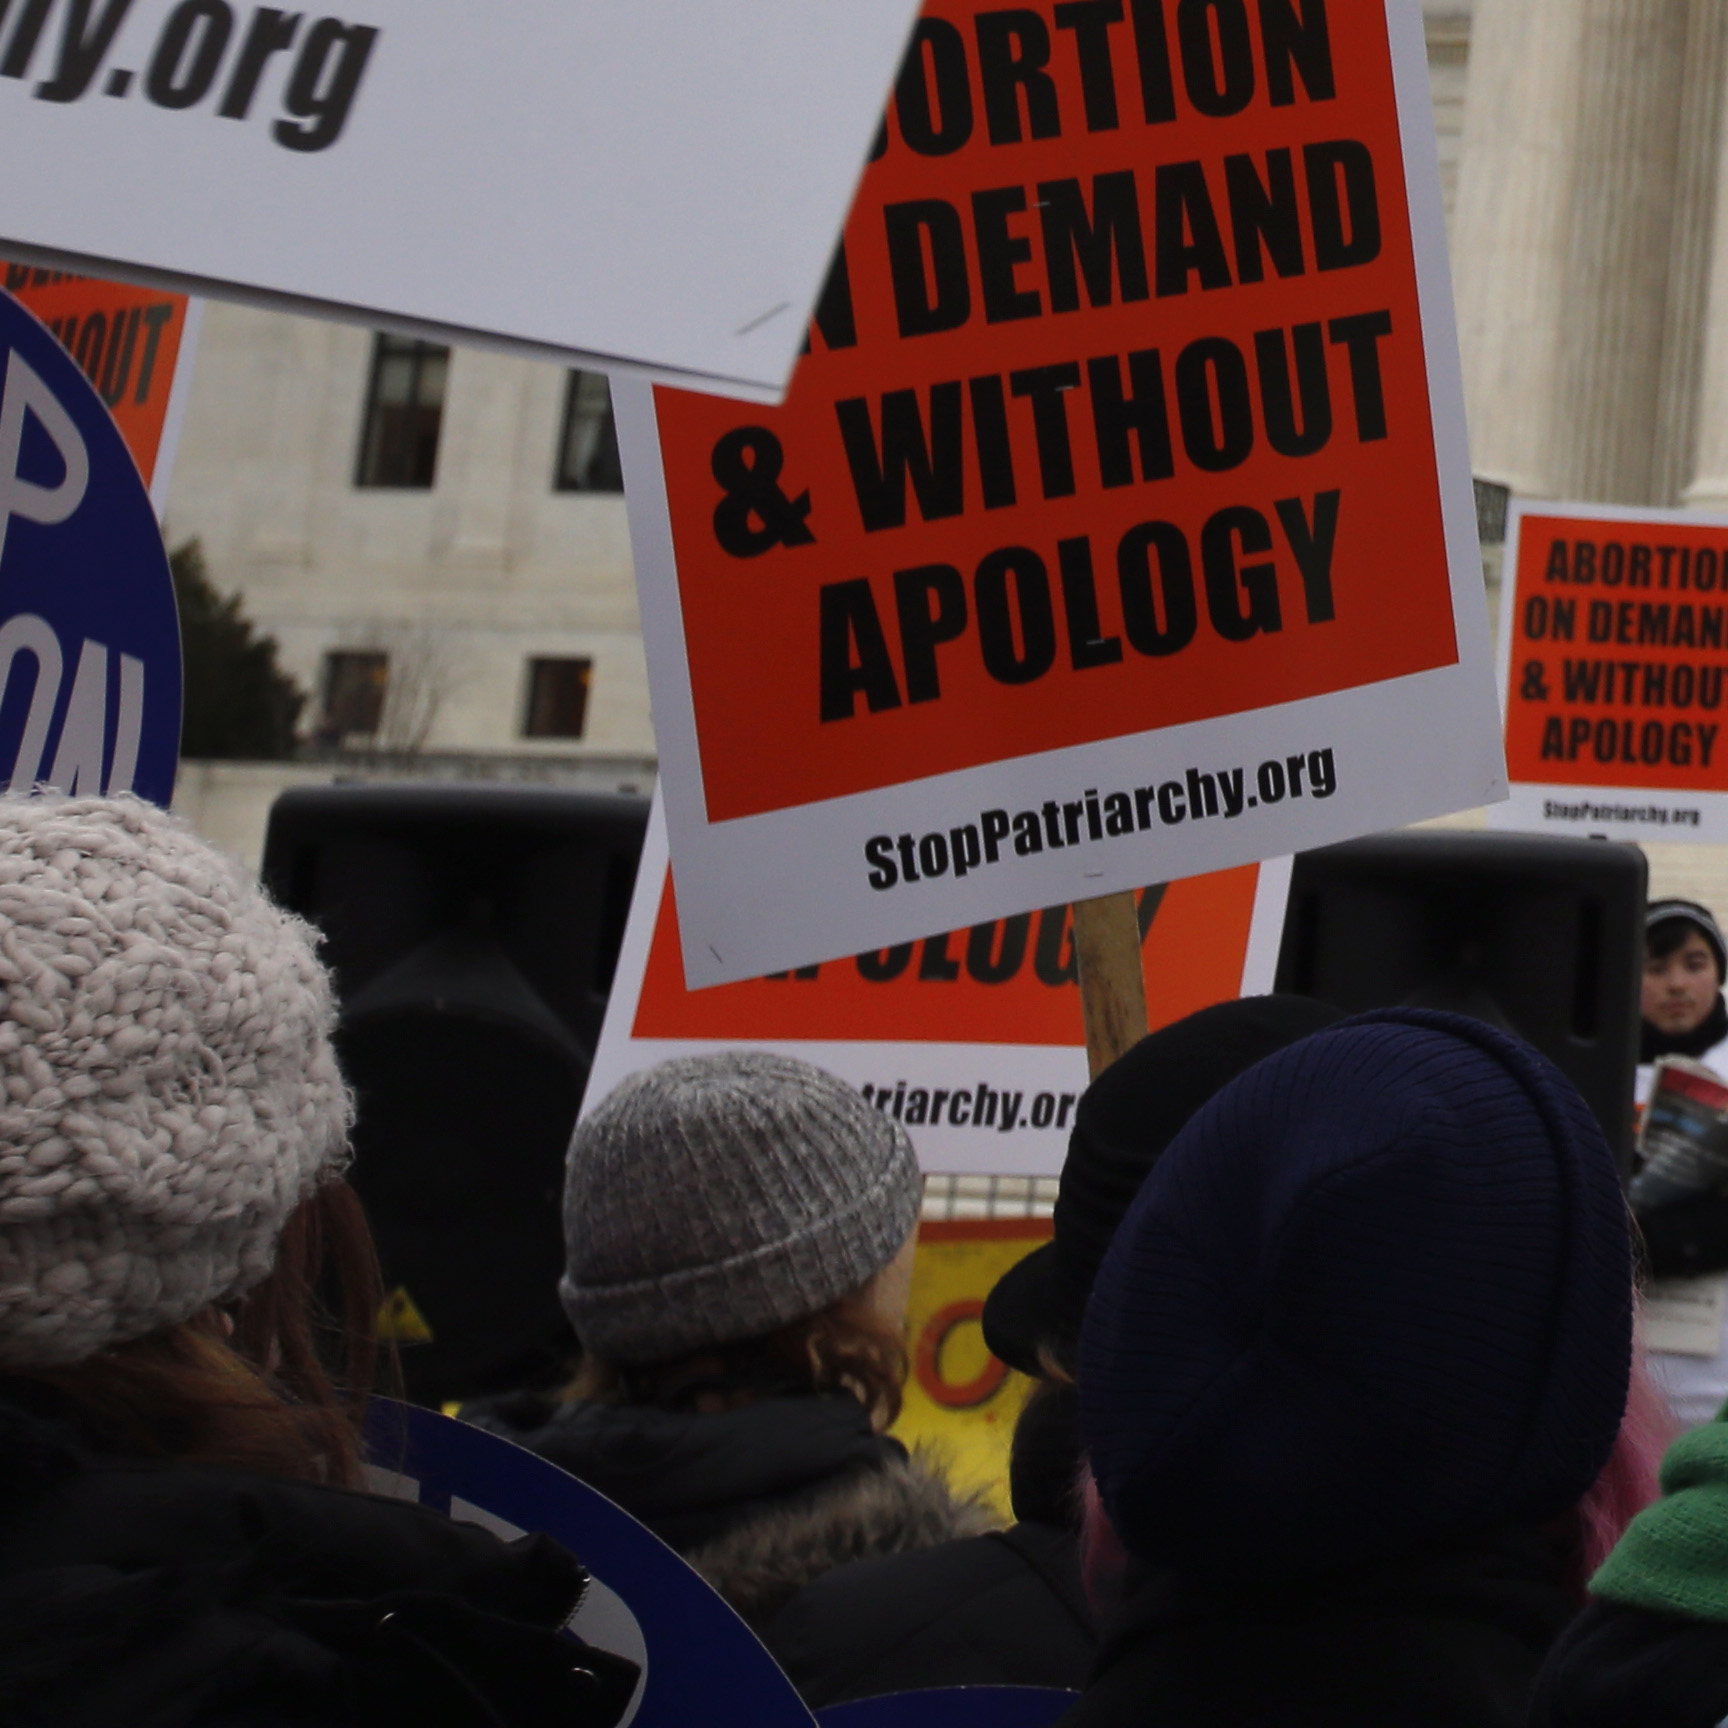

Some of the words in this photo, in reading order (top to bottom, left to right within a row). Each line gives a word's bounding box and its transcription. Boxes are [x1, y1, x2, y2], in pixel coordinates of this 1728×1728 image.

[883, 138, 1381, 339] DEMAND
[710, 424, 816, 560] &
[834, 309, 1393, 534] WITHOUT
[820, 489, 1337, 725] APOLOGY
[1523, 595, 1576, 642] ON
[1520, 659, 1550, 701] &
[1541, 716, 1719, 768] APOLOGY
[865, 747, 1337, 890] StopPatriarchy.org
